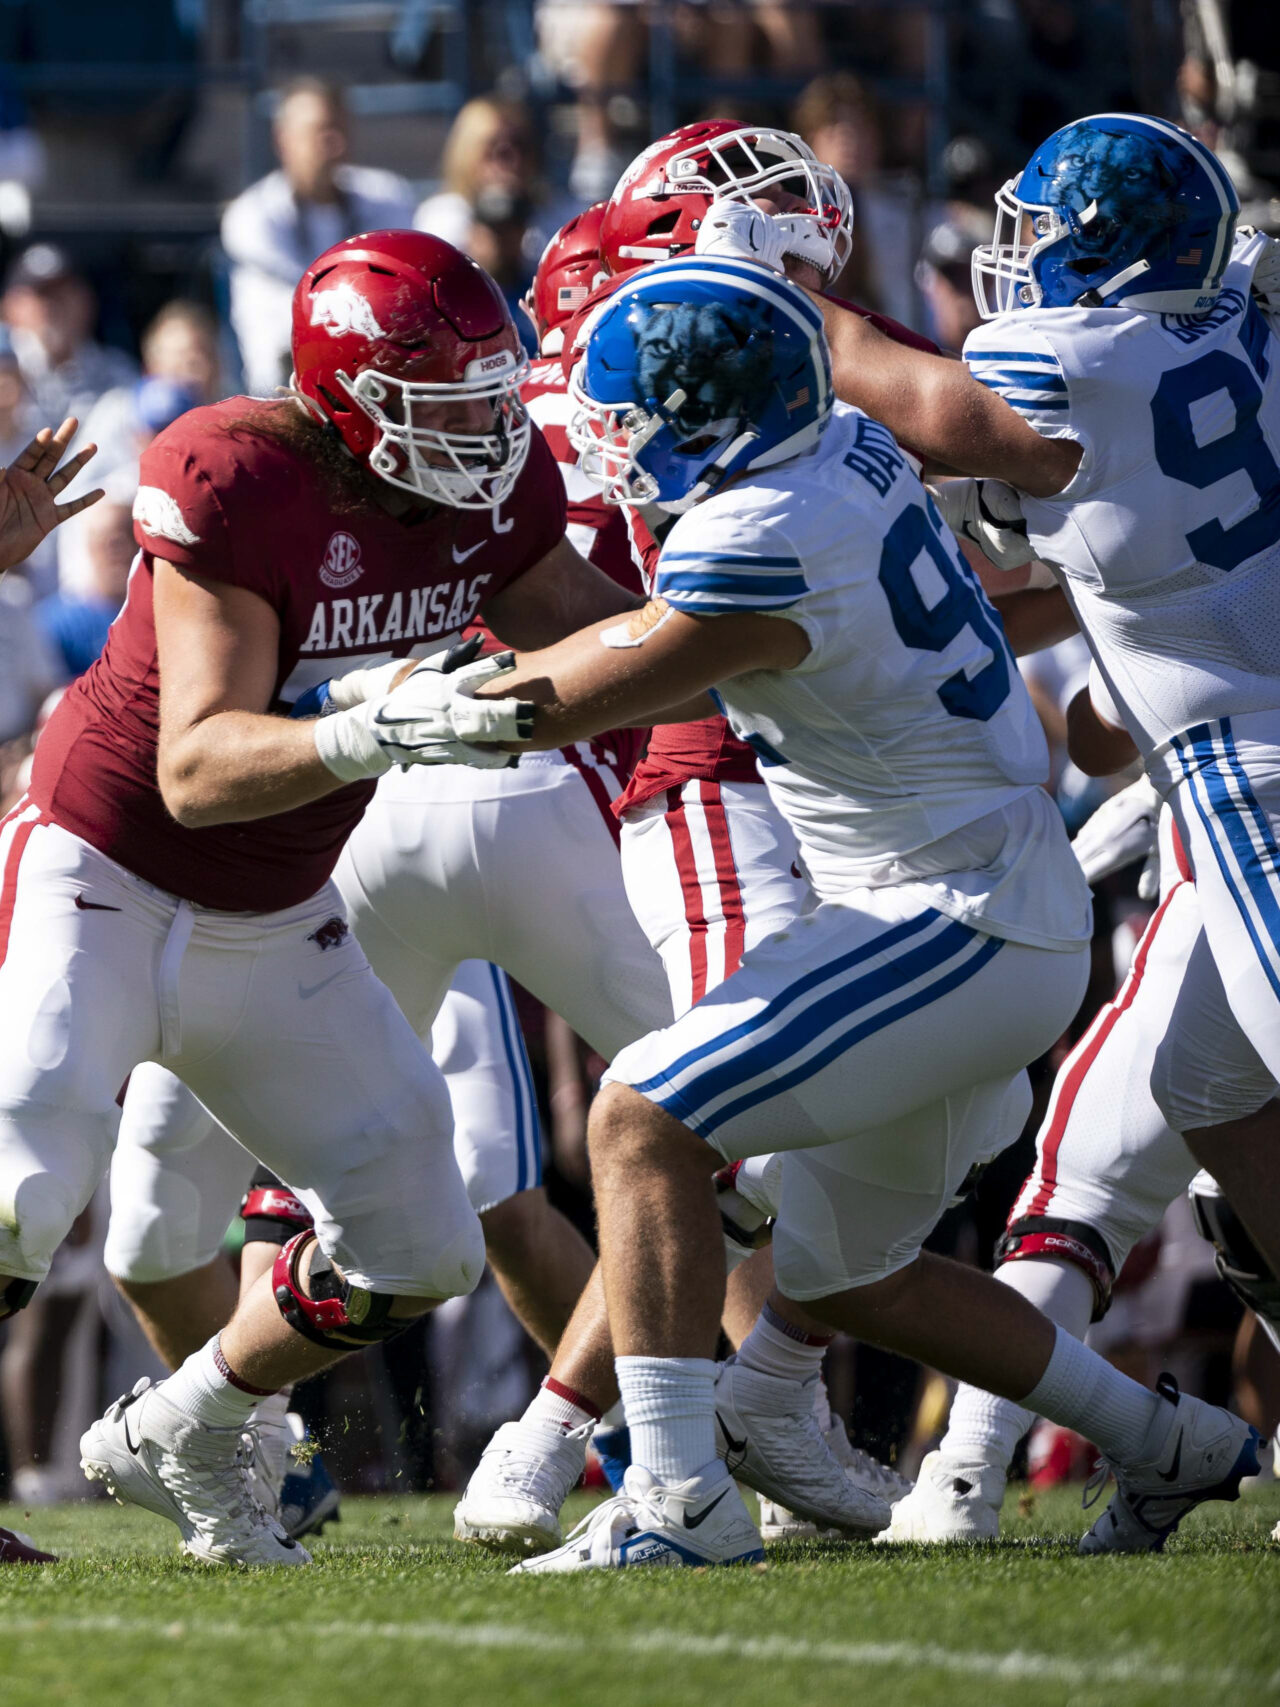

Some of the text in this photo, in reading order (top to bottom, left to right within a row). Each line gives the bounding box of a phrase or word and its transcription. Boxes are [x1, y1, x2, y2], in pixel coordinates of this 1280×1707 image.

[480, 355, 508, 372] HOGS
[326, 534, 357, 573] SEC
[298, 572, 493, 652] ARKANSAS
[631, 1542, 673, 1563] ALPHA
